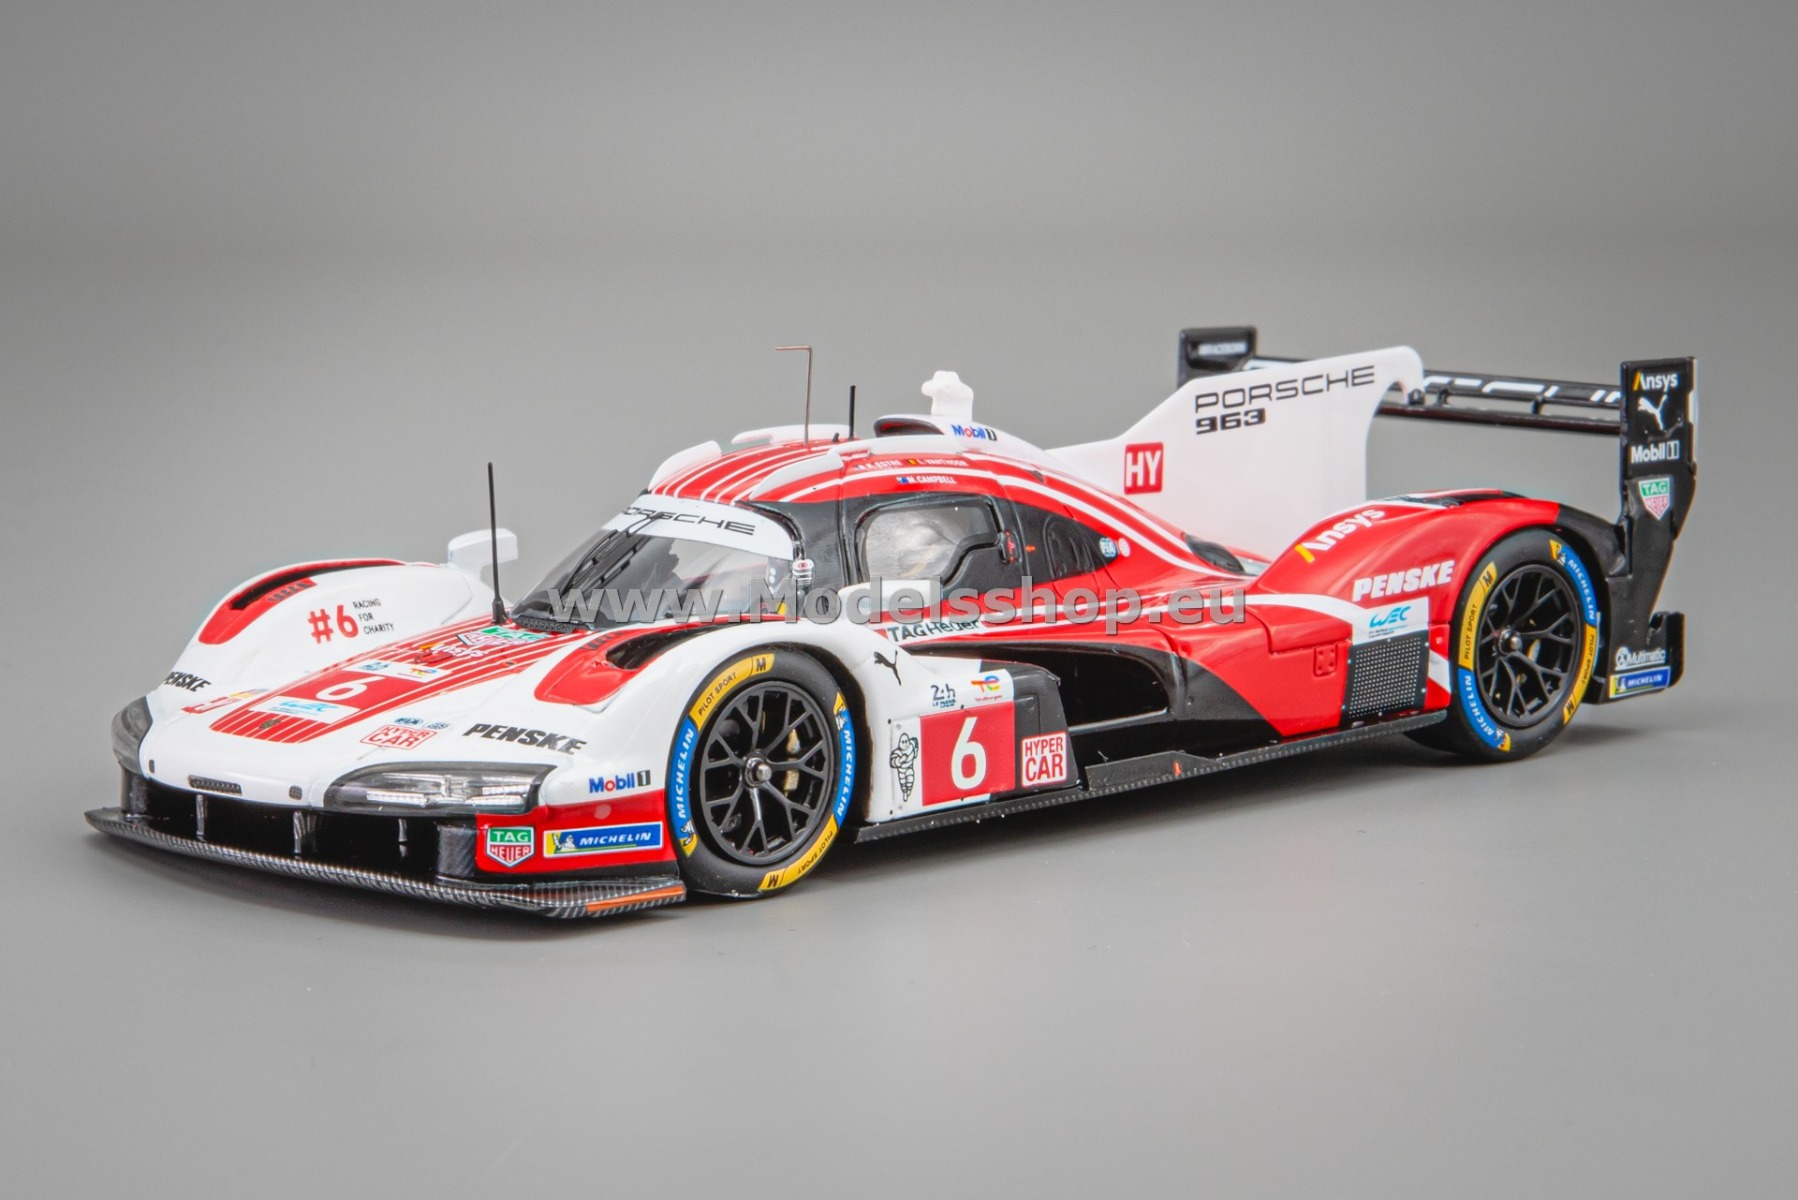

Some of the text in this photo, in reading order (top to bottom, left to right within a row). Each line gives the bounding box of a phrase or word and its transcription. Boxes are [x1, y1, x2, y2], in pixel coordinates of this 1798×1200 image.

[1195, 364, 1375, 414] PORSCHE
[1632, 371, 1679, 392] Ansys
[951, 424, 986, 439] Mobil
[1195, 407, 1266, 435] 963
[1631, 441, 1680, 464] Mobil 1
[1126, 450, 1162, 487] HY
[1642, 483, 1668, 495] TAG
[1294, 508, 1386, 563] Ansys
[1352, 560, 1455, 602] PENSKE
[1482, 570, 1494, 587] M
[1568, 559, 1595, 620] MICHELIN
[352, 598, 382, 609] RACING
[307, 604, 359, 644] #6
[358, 612, 374, 622] FOR
[363, 622, 394, 635] CHARITY
[1369, 605, 1412, 628] WEC
[886, 624, 928, 642] TAG
[1464, 604, 1478, 660] PILOT SPORT
[755, 655, 767, 672] M
[315, 674, 387, 702] 6
[1627, 674, 1663, 687] MICHELIN
[697, 671, 737, 718] PILOT SPORT
[1464, 675, 1494, 736] MICHELIN
[368, 733, 417, 747] CAR
[381, 725, 428, 738] HYPER
[462, 723, 588, 755] PENSKE
[950, 716, 987, 791] 6
[1024, 736, 1064, 758] HYPER
[675, 728, 695, 819] MICHELIN
[837, 729, 854, 817] MICHELIN
[1025, 753, 1065, 782] CAR
[589, 769, 652, 794] Mobil 1
[494, 830, 529, 843] TAG
[579, 832, 652, 846] MICHELIN
[490, 845, 530, 862] HEUER
[796, 829, 834, 875] PILOT SPORT
